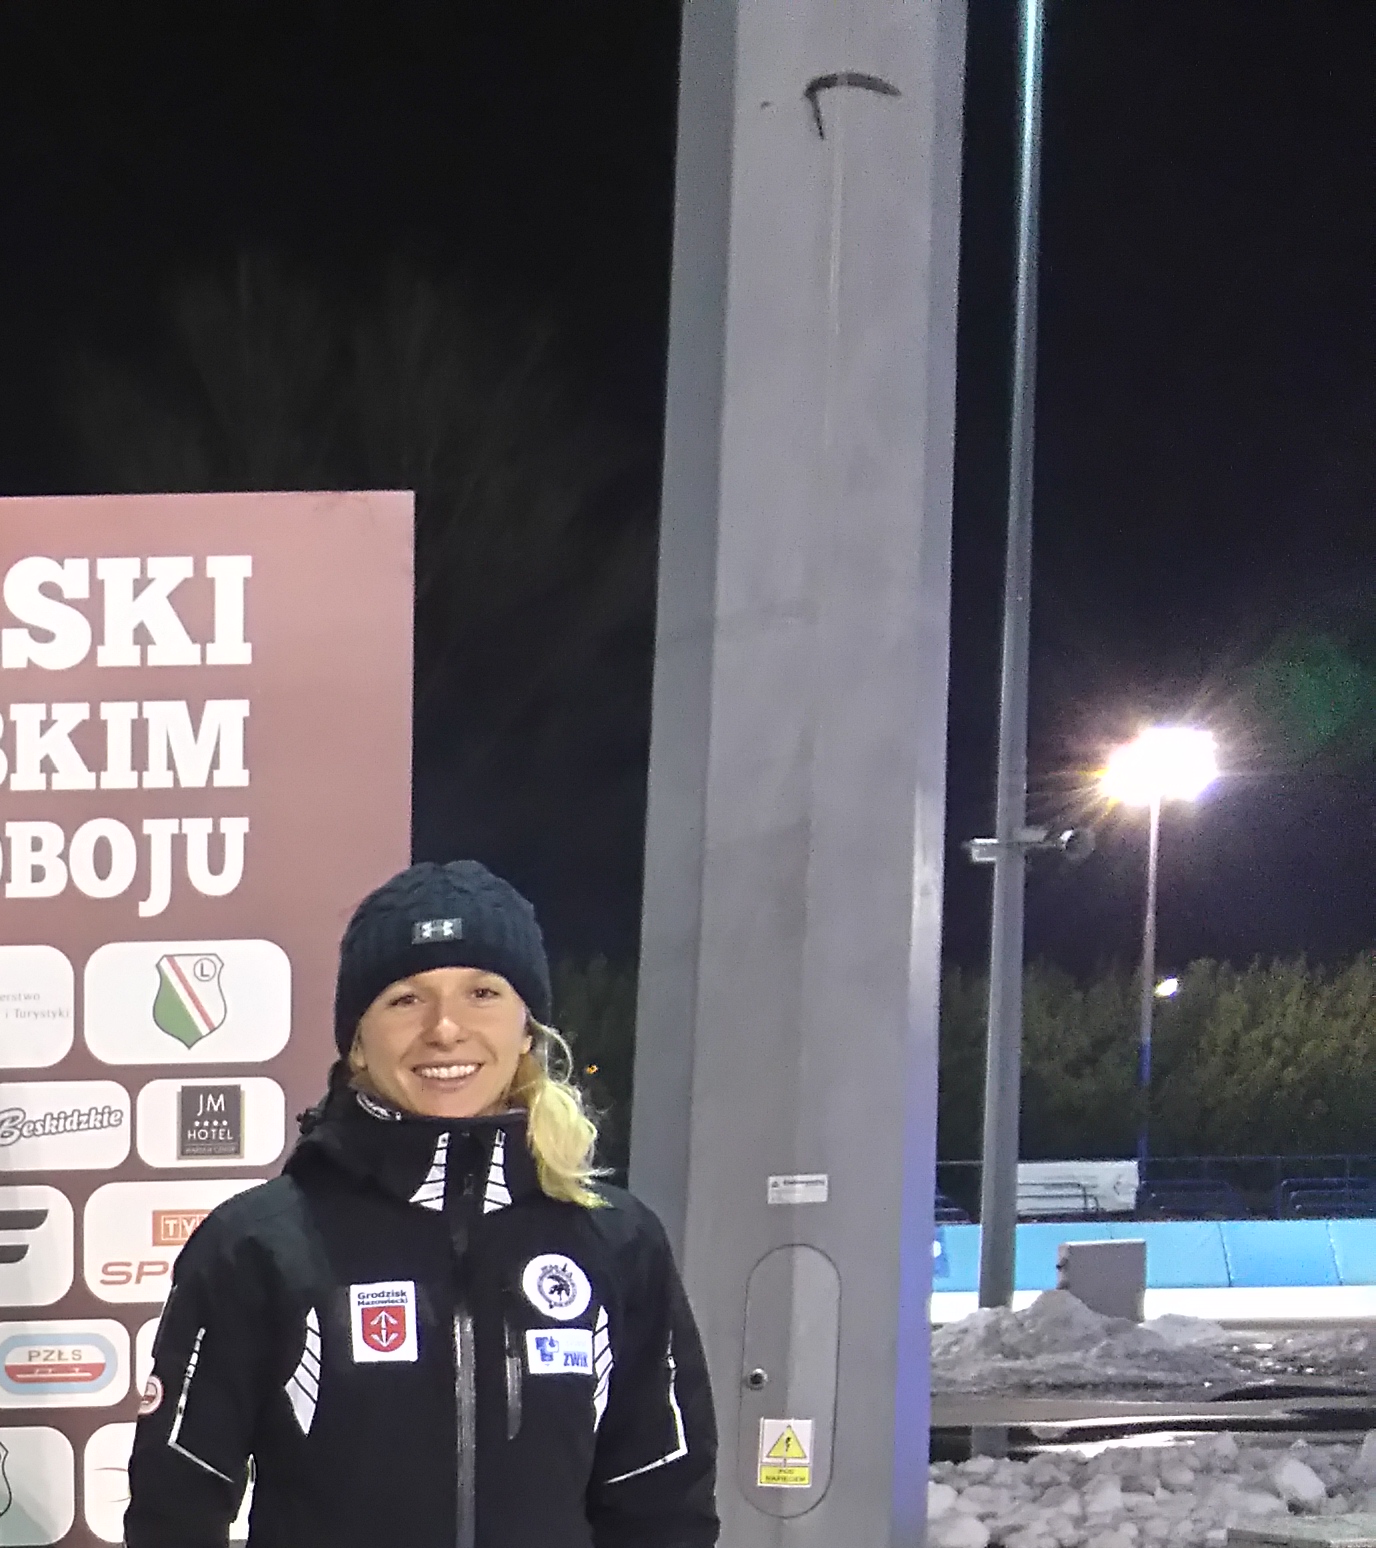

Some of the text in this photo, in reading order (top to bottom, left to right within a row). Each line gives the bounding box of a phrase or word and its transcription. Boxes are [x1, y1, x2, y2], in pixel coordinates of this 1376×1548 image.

[13, 1006, 71, 1020] Turystyki
[196, 1093, 225, 1117] JM
[187, 1128, 234, 1140] HOTEL
[357, 1289, 407, 1300] Grodzisk
[27, 1347, 83, 1362] PZŁS
